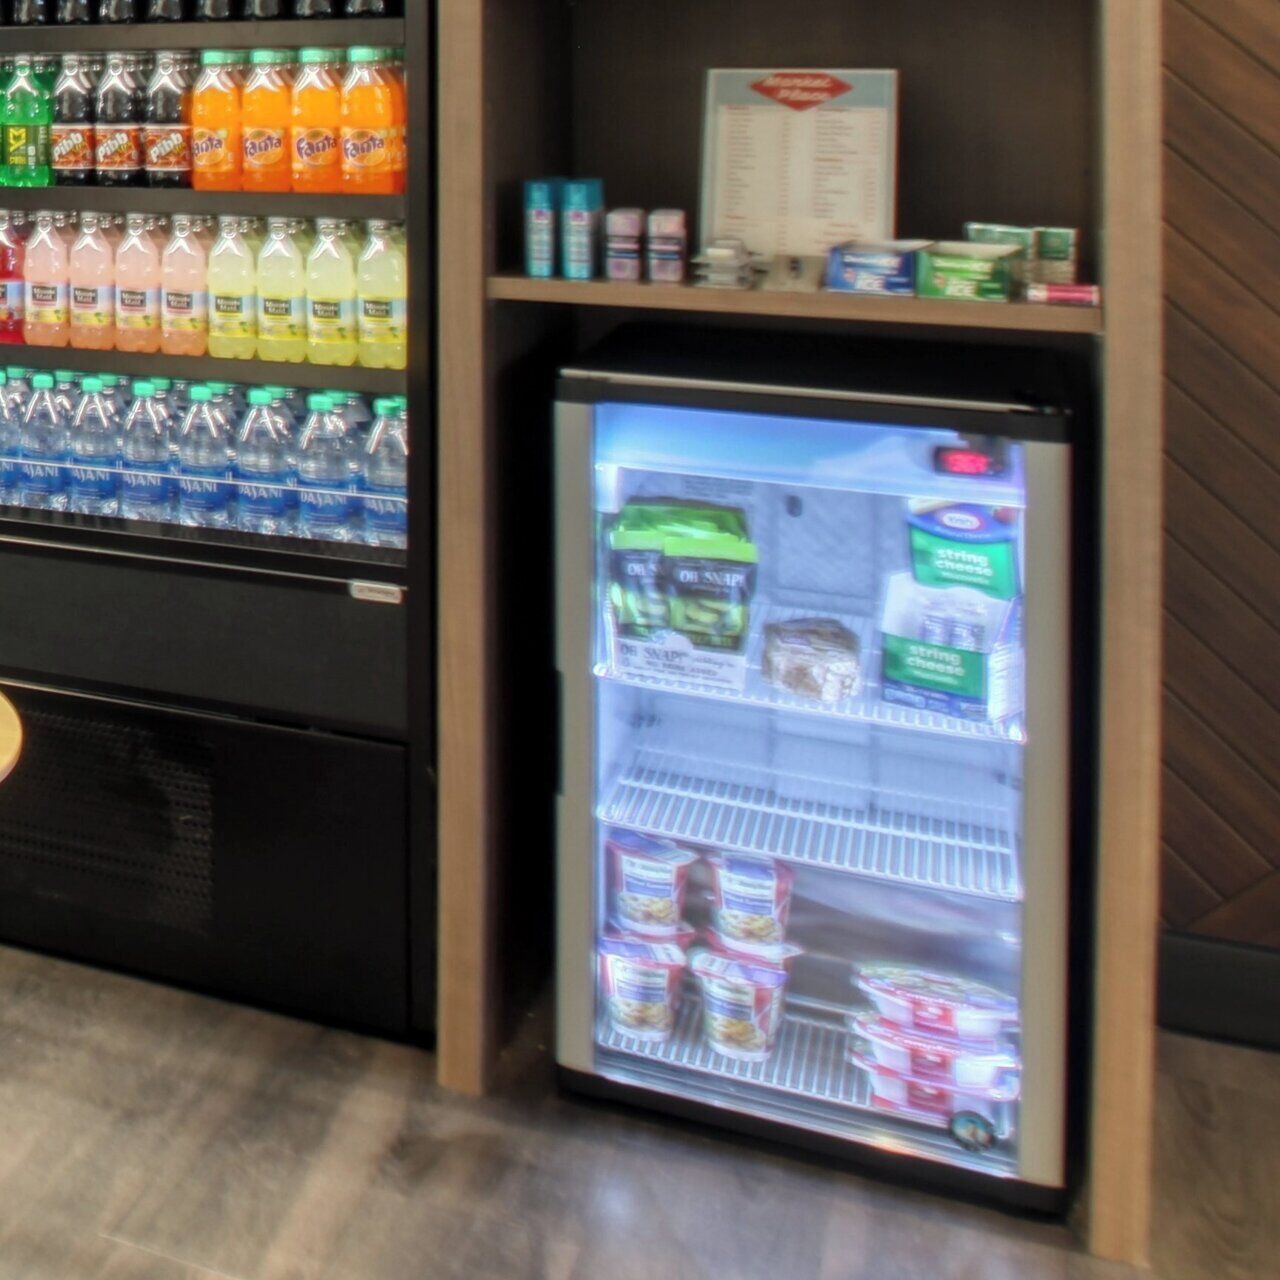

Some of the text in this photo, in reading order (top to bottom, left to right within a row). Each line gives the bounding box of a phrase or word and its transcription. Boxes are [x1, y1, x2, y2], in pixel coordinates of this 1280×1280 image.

[194, 134, 223, 154] anta
[297, 136, 337, 160] Fanta
[938, 548, 988, 566] string
[936, 558, 993, 576] cheese
[680, 572, 698, 583] OH
[910, 645, 962, 664] string
[906, 656, 965, 676] cheese
